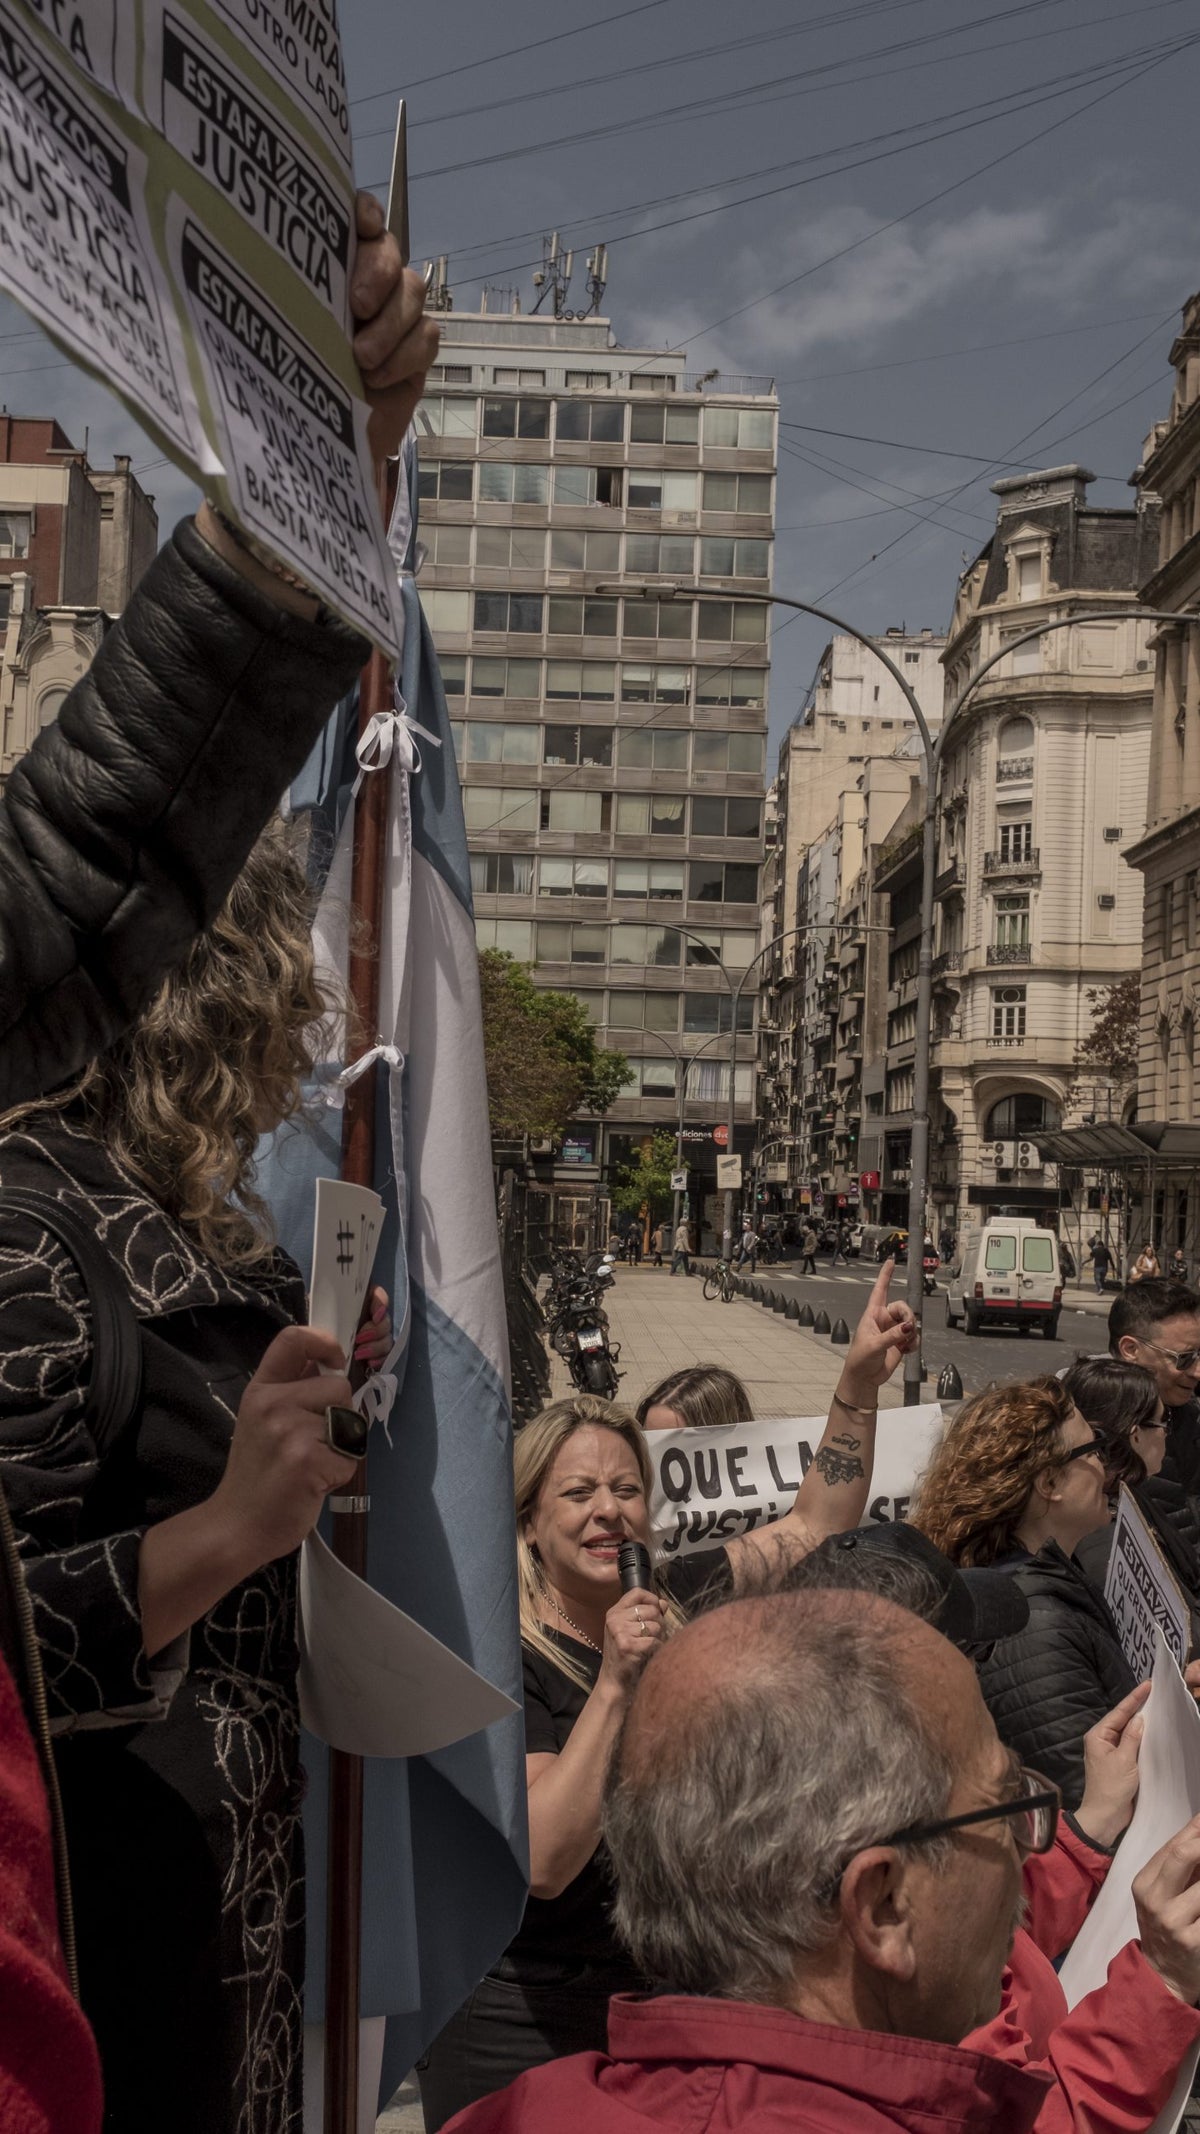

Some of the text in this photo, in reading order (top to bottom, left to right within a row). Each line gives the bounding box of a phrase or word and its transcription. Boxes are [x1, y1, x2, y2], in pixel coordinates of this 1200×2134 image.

[305, 56, 349, 135] LADO
[0, 123, 155, 323] USTICIA
[80, 174, 138, 254] QUE
[192, 117, 333, 304] JUSTICIA
[203, 318, 356, 491] QUEREMOS QUE
[216, 359, 374, 545] LA JUSTICIA
[244, 463, 391, 625] BASTA VUELTAS
[262, 444, 362, 563] SE EXPIDA
[990, 1239, 1001, 1248] 110
[660, 1446, 758, 1503] QUE
[1112, 1578, 1125, 1622] LA
